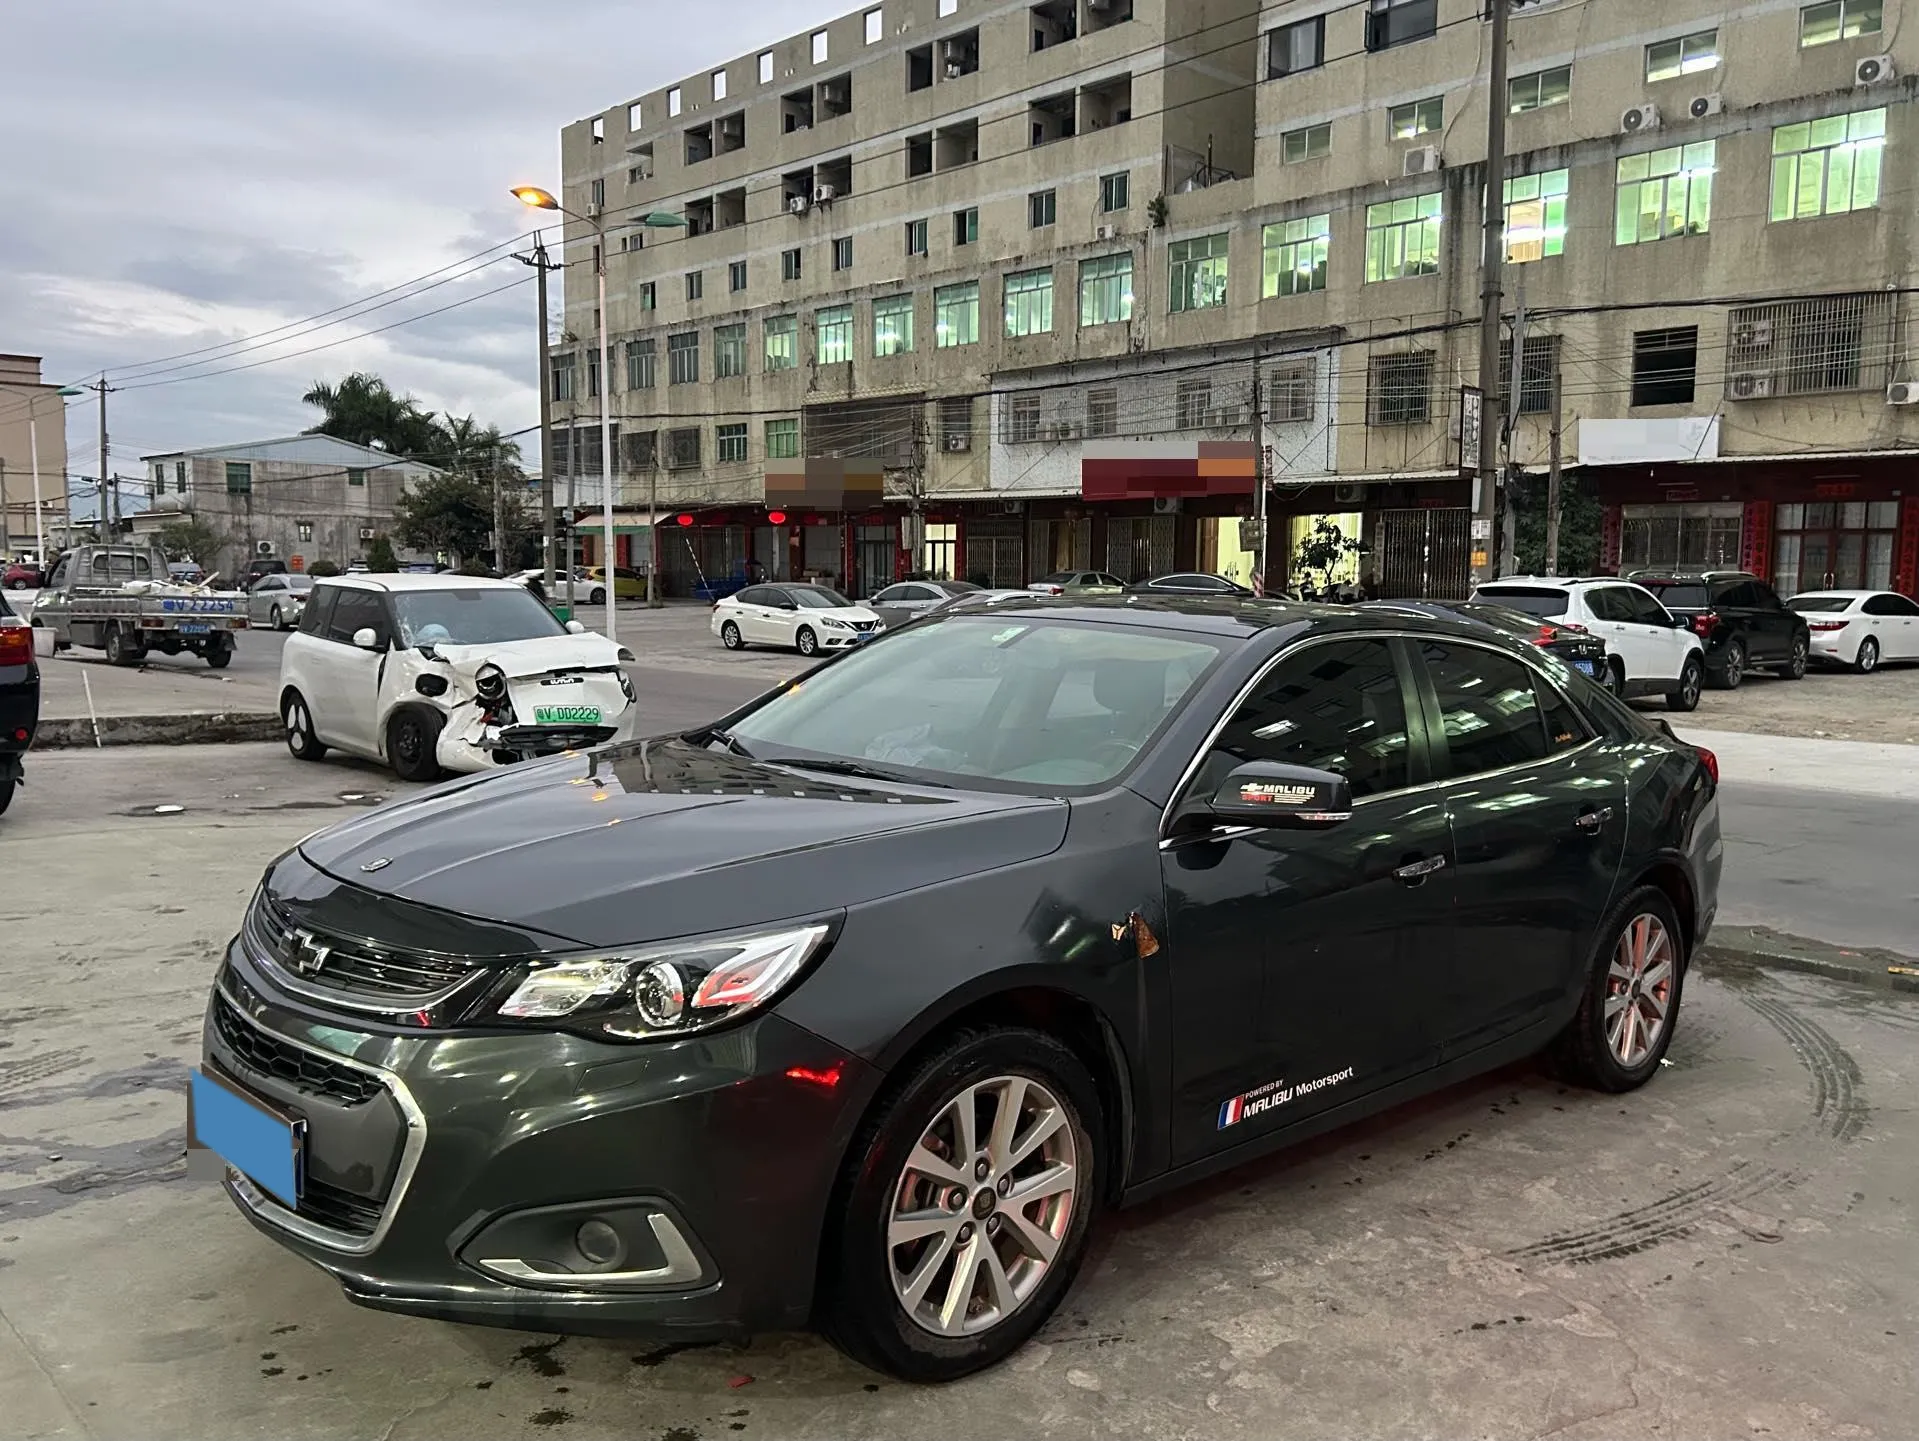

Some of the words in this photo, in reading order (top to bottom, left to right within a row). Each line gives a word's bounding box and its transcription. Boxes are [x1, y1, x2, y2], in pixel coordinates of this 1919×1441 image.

[557, 706, 599, 720] DD2229
[1263, 784, 1316, 795] MALIBU
[1241, 794, 1273, 803] SPORT
[1243, 1087, 1294, 1119] MALIBU
[1296, 1066, 1354, 1097] Motorsport
[1245, 1082, 1275, 1099] POWERED
[1275, 1079, 1285, 1089] BY
